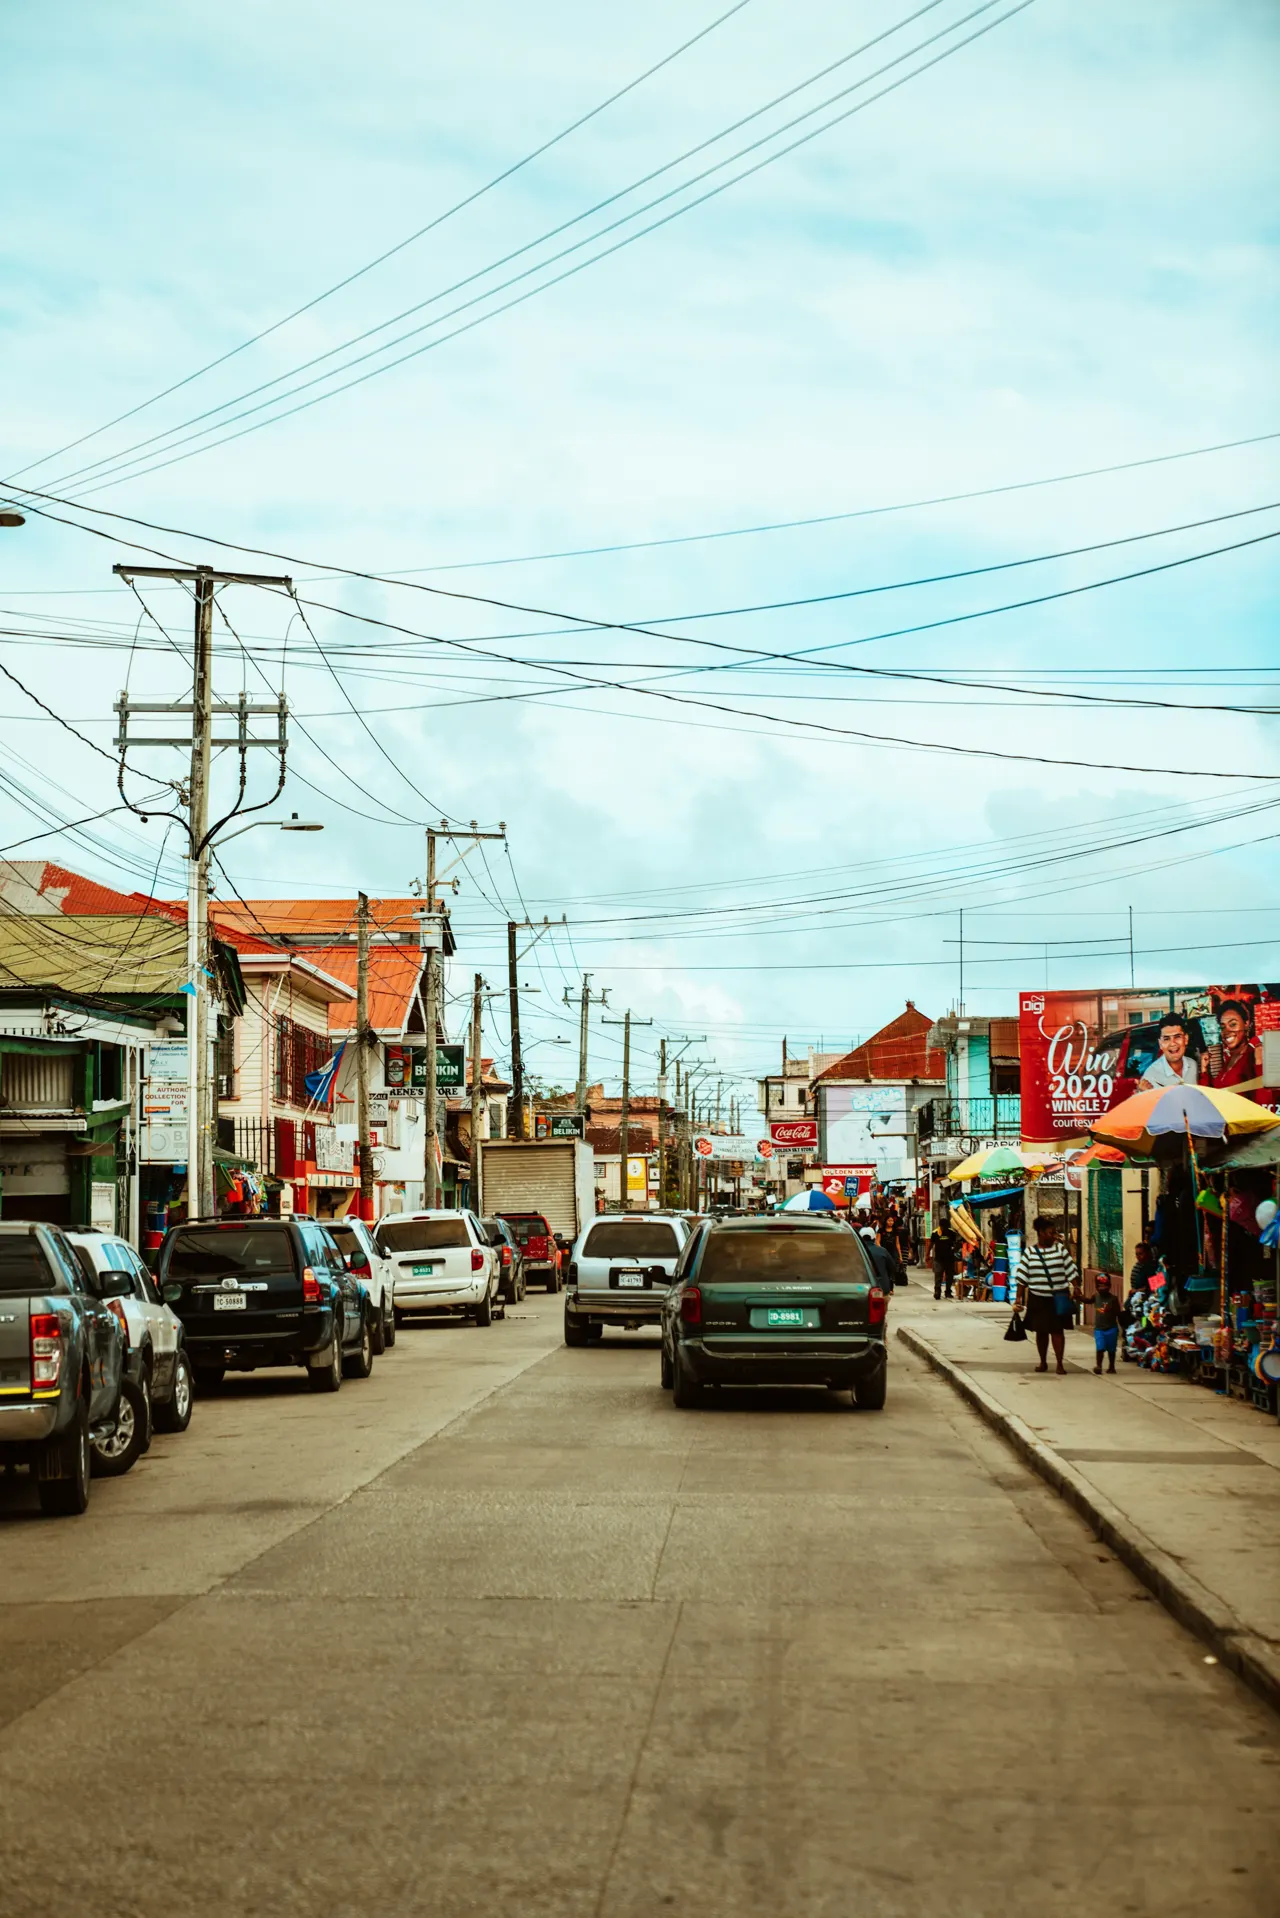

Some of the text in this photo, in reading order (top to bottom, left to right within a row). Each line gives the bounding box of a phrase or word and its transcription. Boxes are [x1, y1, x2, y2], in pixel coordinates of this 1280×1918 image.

[1023, 995, 1045, 1014] Digi
[1038, 1015, 1116, 1076] Win
[1052, 1075, 1114, 1098] 2020
[1052, 1099, 1110, 1112] WINGLE 7
[1053, 1119, 1093, 1128] courtesy
[775, 1126, 812, 1139] Coca-Cola
